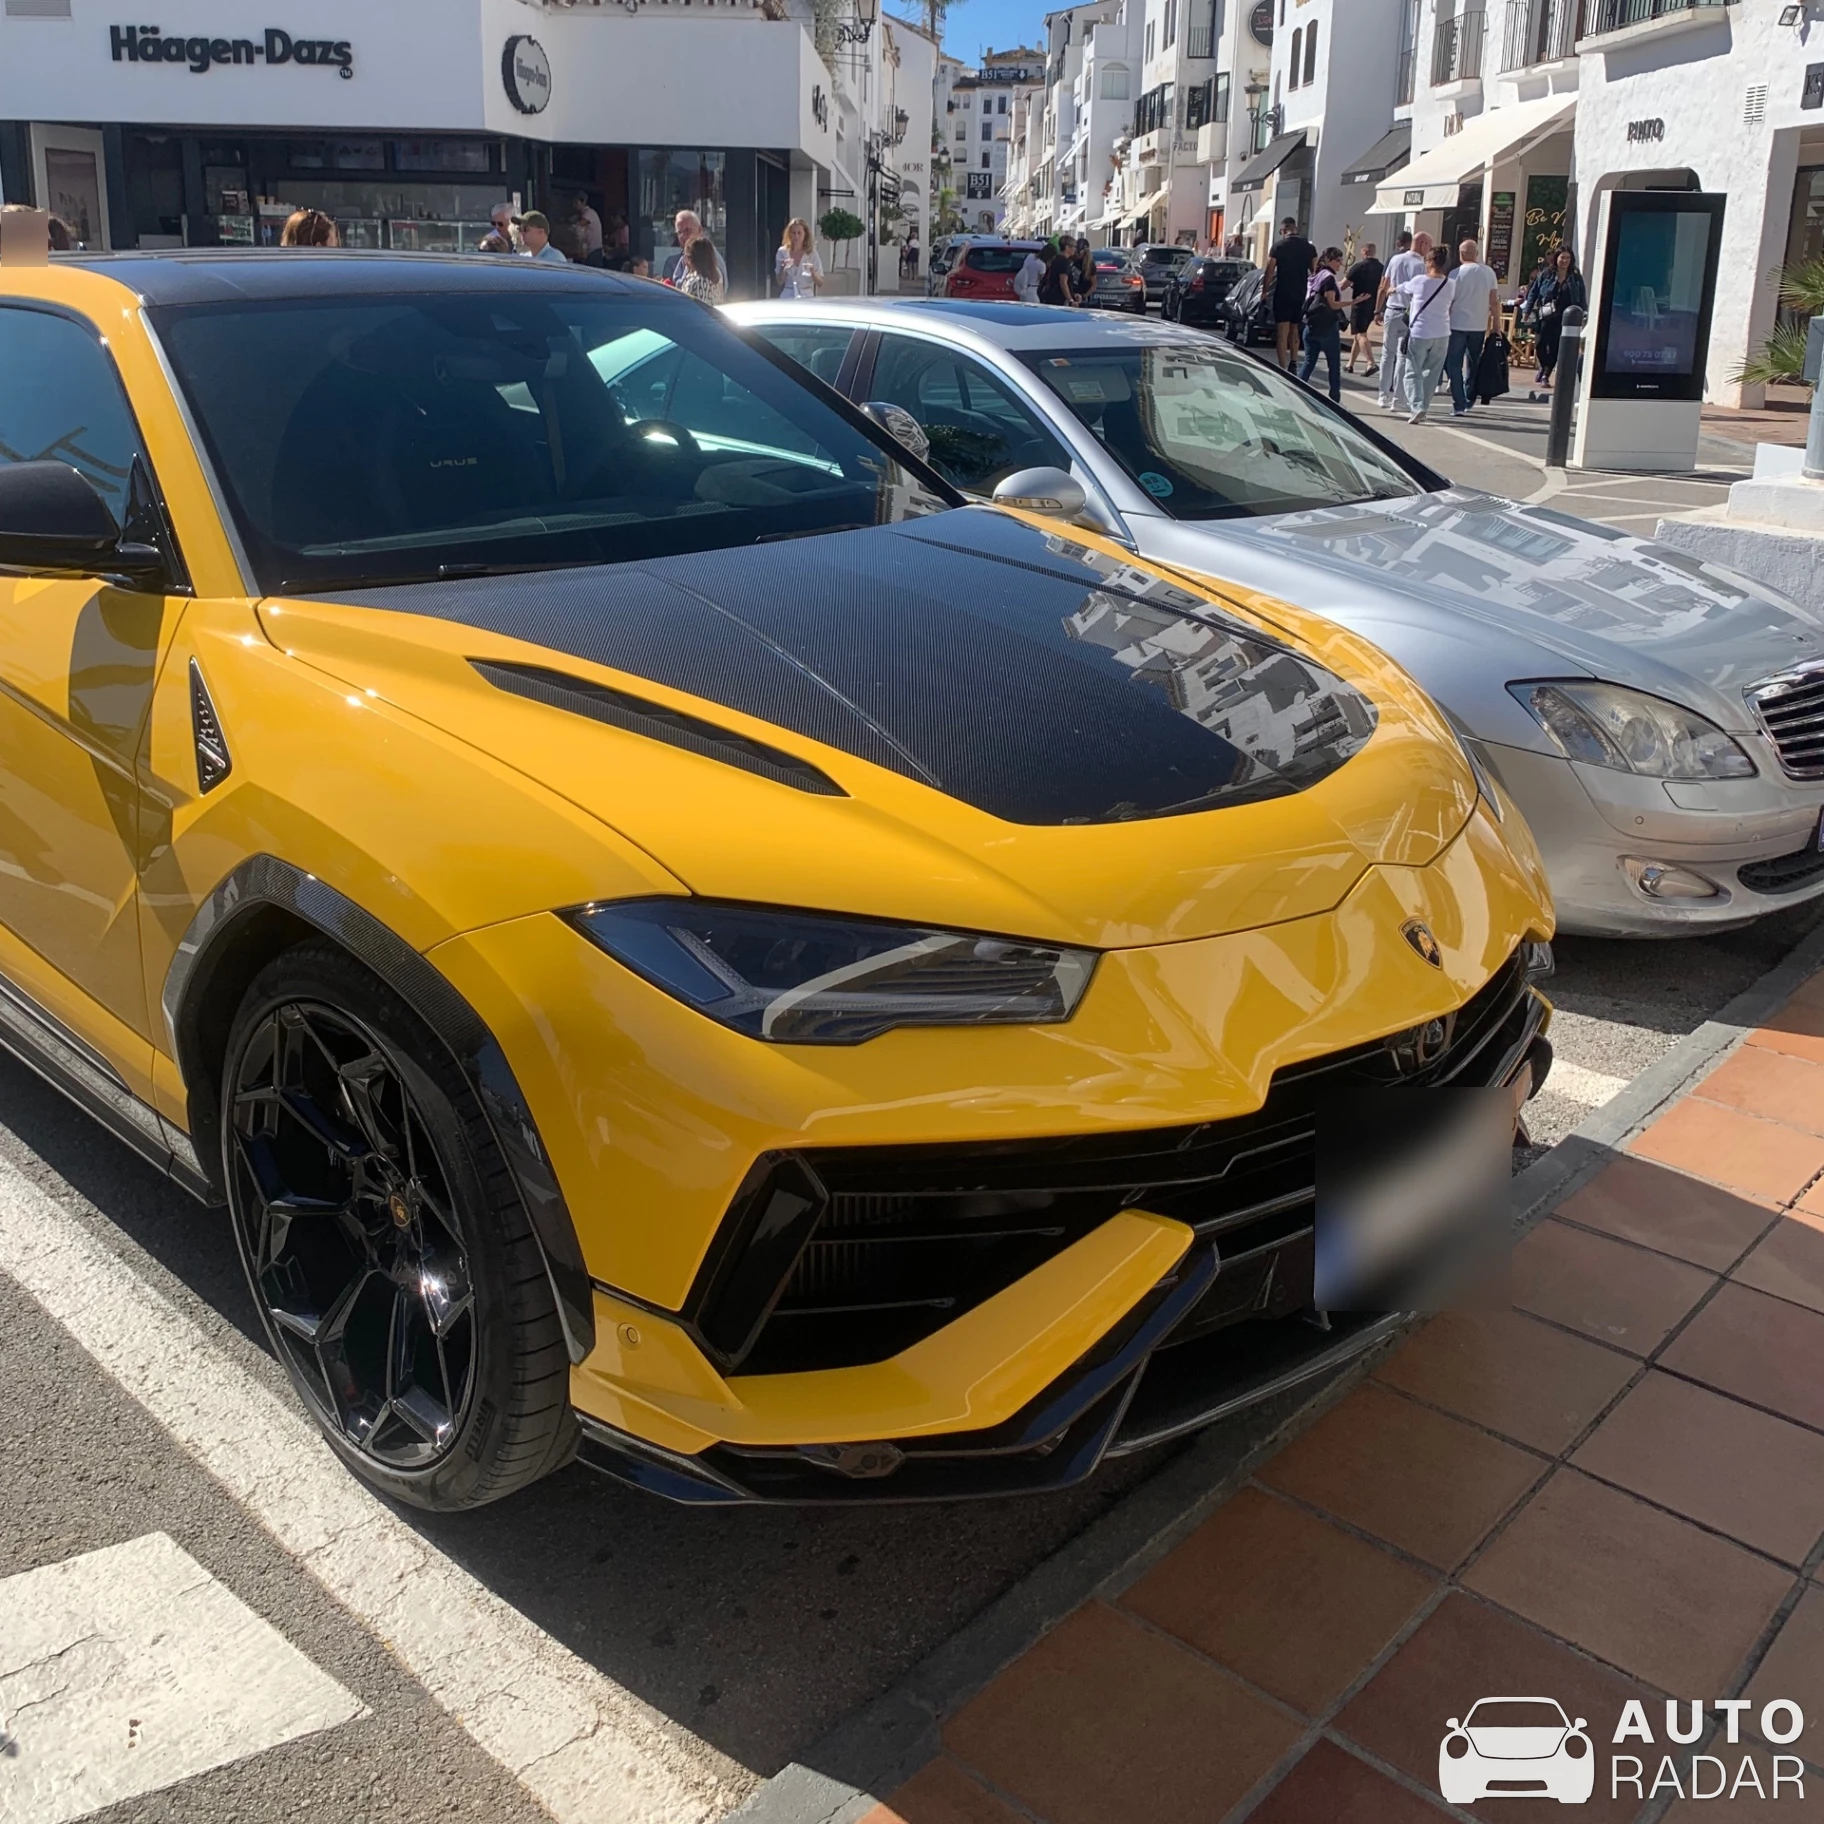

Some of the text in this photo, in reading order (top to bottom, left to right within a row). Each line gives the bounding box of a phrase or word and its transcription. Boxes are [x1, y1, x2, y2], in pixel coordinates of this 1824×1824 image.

[109, 25, 353, 73] Häagen-Dazs
[981, 70, 997, 80] B51
[1627, 118, 1664, 142] PINTO
[970, 174, 989, 186] B51
[1526, 208, 1548, 226] Be
[430, 456, 478, 468] URUS
